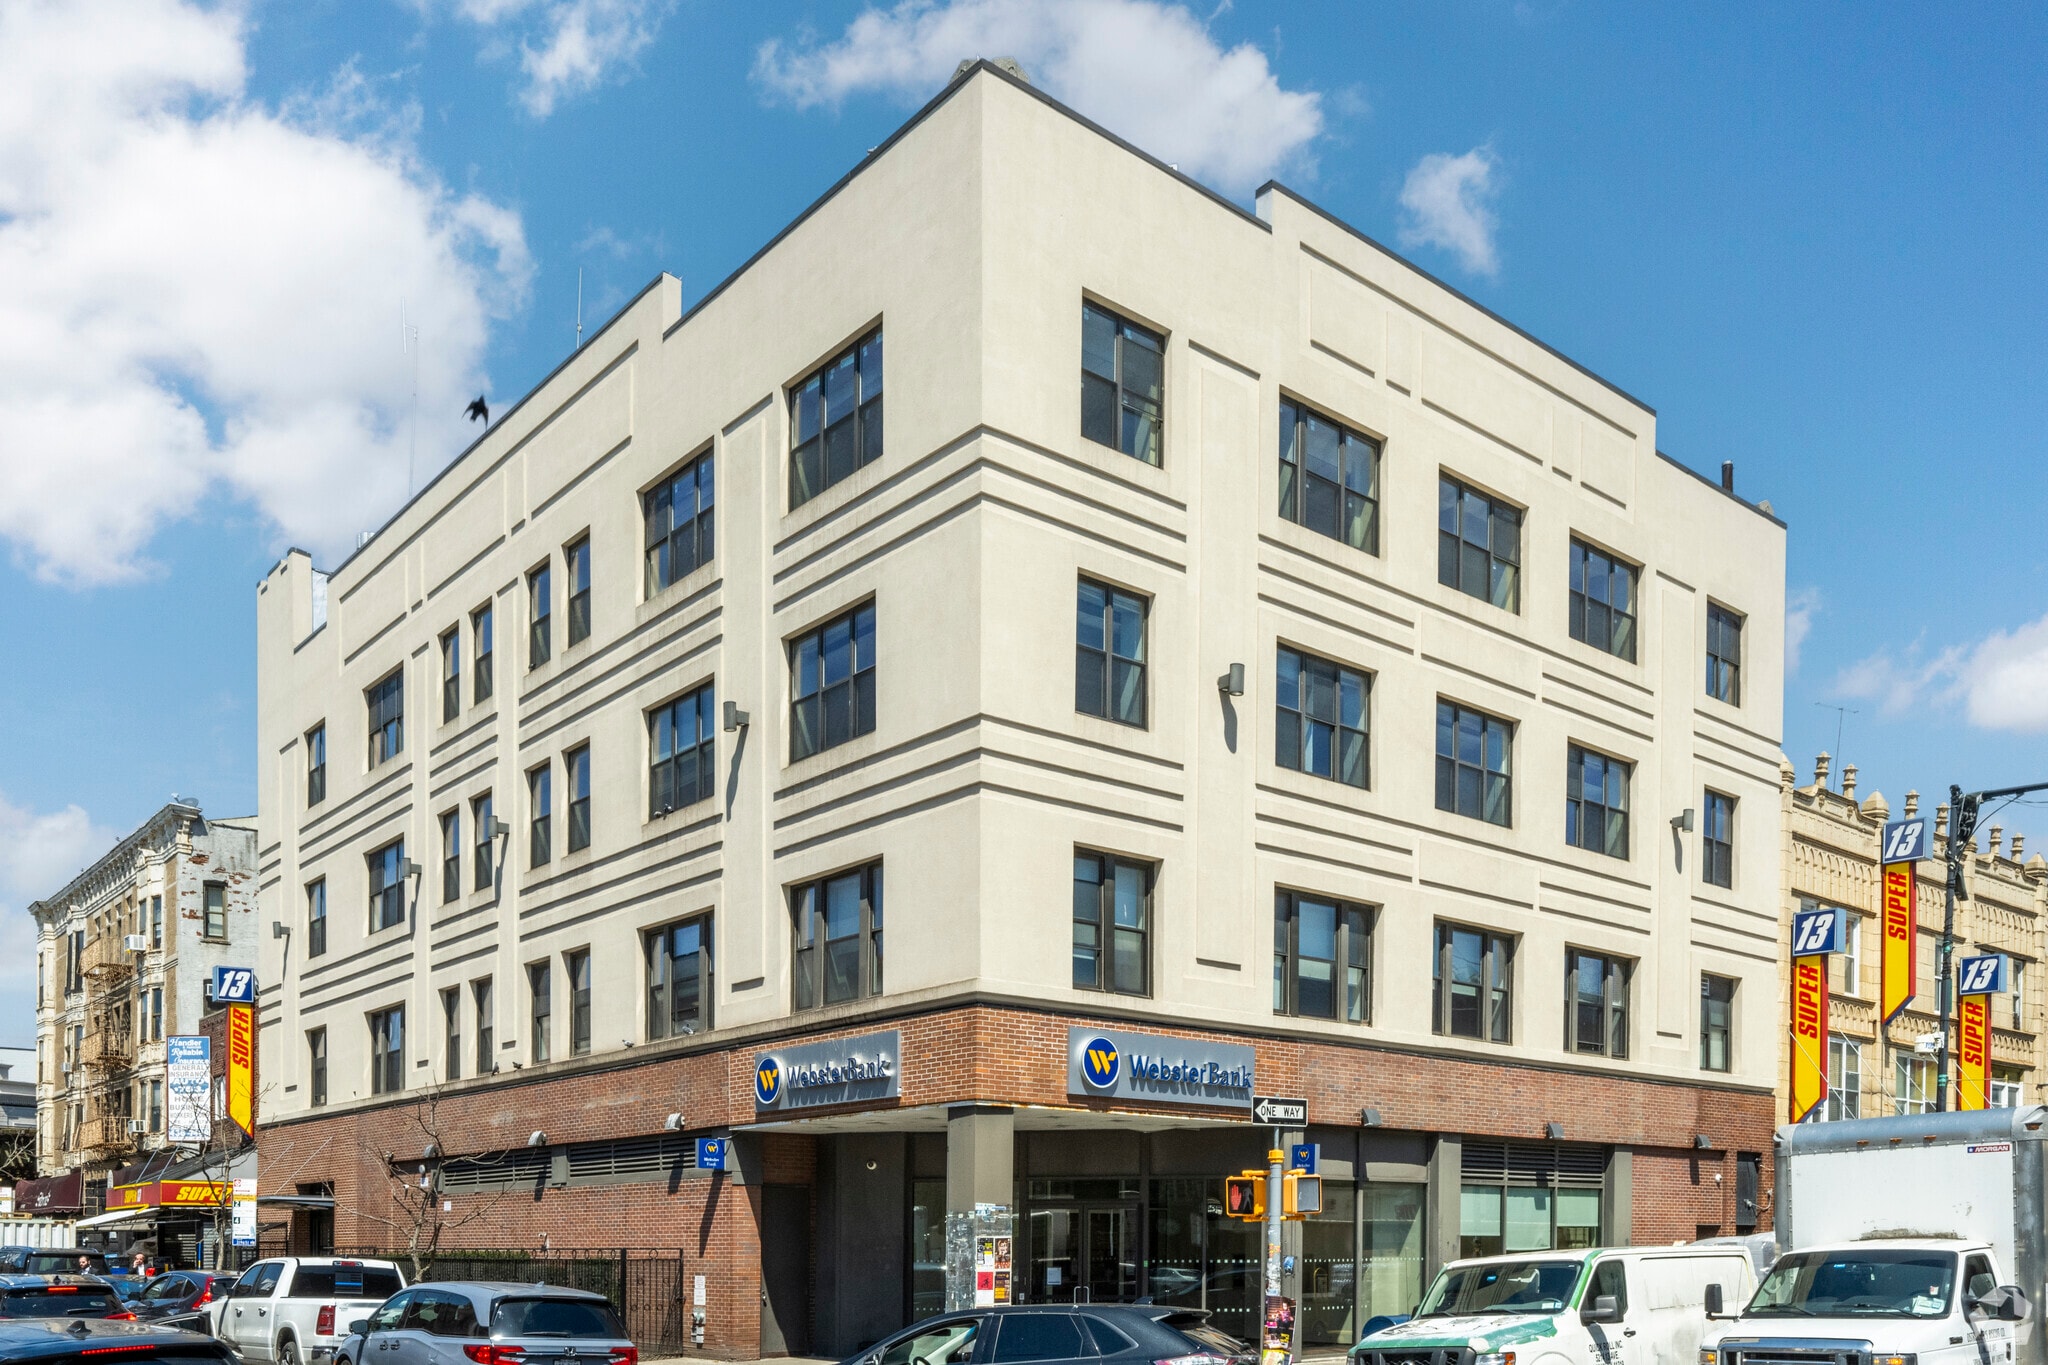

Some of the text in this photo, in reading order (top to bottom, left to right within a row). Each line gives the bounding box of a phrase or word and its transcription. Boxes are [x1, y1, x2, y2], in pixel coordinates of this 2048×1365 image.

[1885, 822, 1923, 859] 13
[1888, 871, 1907, 941] SUPER
[1795, 913, 1834, 951] 13
[219, 970, 251, 998] 13
[1962, 958, 1998, 991] 13
[1798, 964, 1819, 1039] SUPER
[170, 1037, 202, 1047] Handler
[232, 1007, 249, 1069] SUPER
[1964, 1001, 1983, 1067] SUPER
[171, 1047, 204, 1057] Reliable
[1260, 1105, 1300, 1117] ONE WAY
[1974, 1145, 2009, 1153] MORGAN
[176, 1186, 232, 1201] SUPER
